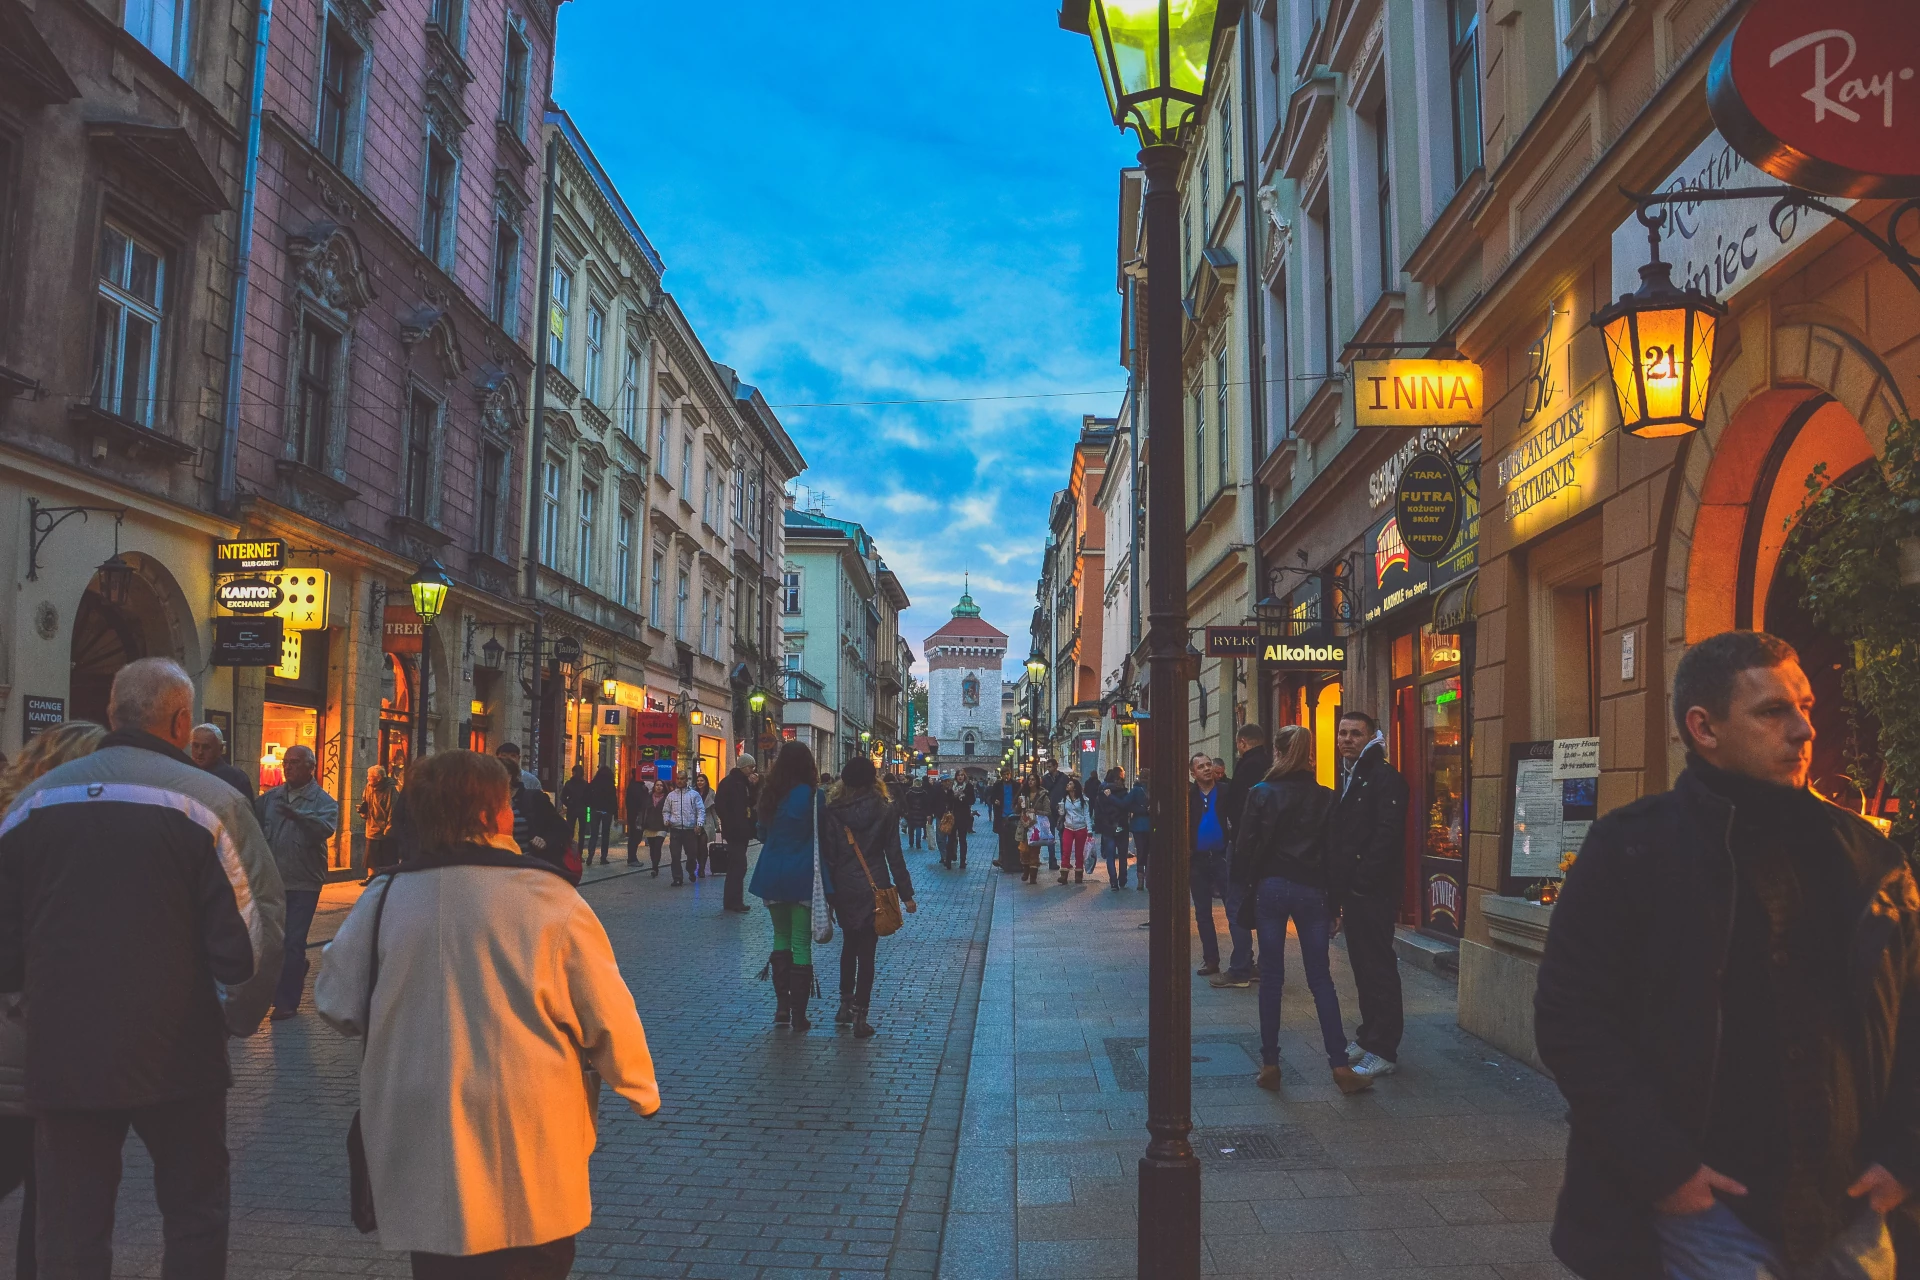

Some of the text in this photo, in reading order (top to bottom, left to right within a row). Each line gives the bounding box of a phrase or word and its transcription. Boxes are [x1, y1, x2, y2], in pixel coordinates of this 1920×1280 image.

[1645, 344, 1679, 381] 21
[1367, 376, 1474, 411] INNA
[1546, 400, 1584, 456] HOUSE
[1413, 471, 1442, 479] TARA
[1504, 451, 1575, 523] APARTMENTS
[1401, 491, 1454, 501] FUTRA
[1407, 504, 1446, 512] KOŻUCHY
[1412, 515, 1440, 523] SKÓRY
[1413, 535, 1444, 543] PIĘTRO
[218, 542, 280, 560] INTERNET
[221, 586, 278, 598] KANTOR
[226, 600, 270, 608] EXCHANGE
[1263, 644, 1344, 661] Alkohole
[28, 700, 62, 711] CHANGE
[28, 711, 63, 723] KANTOR
